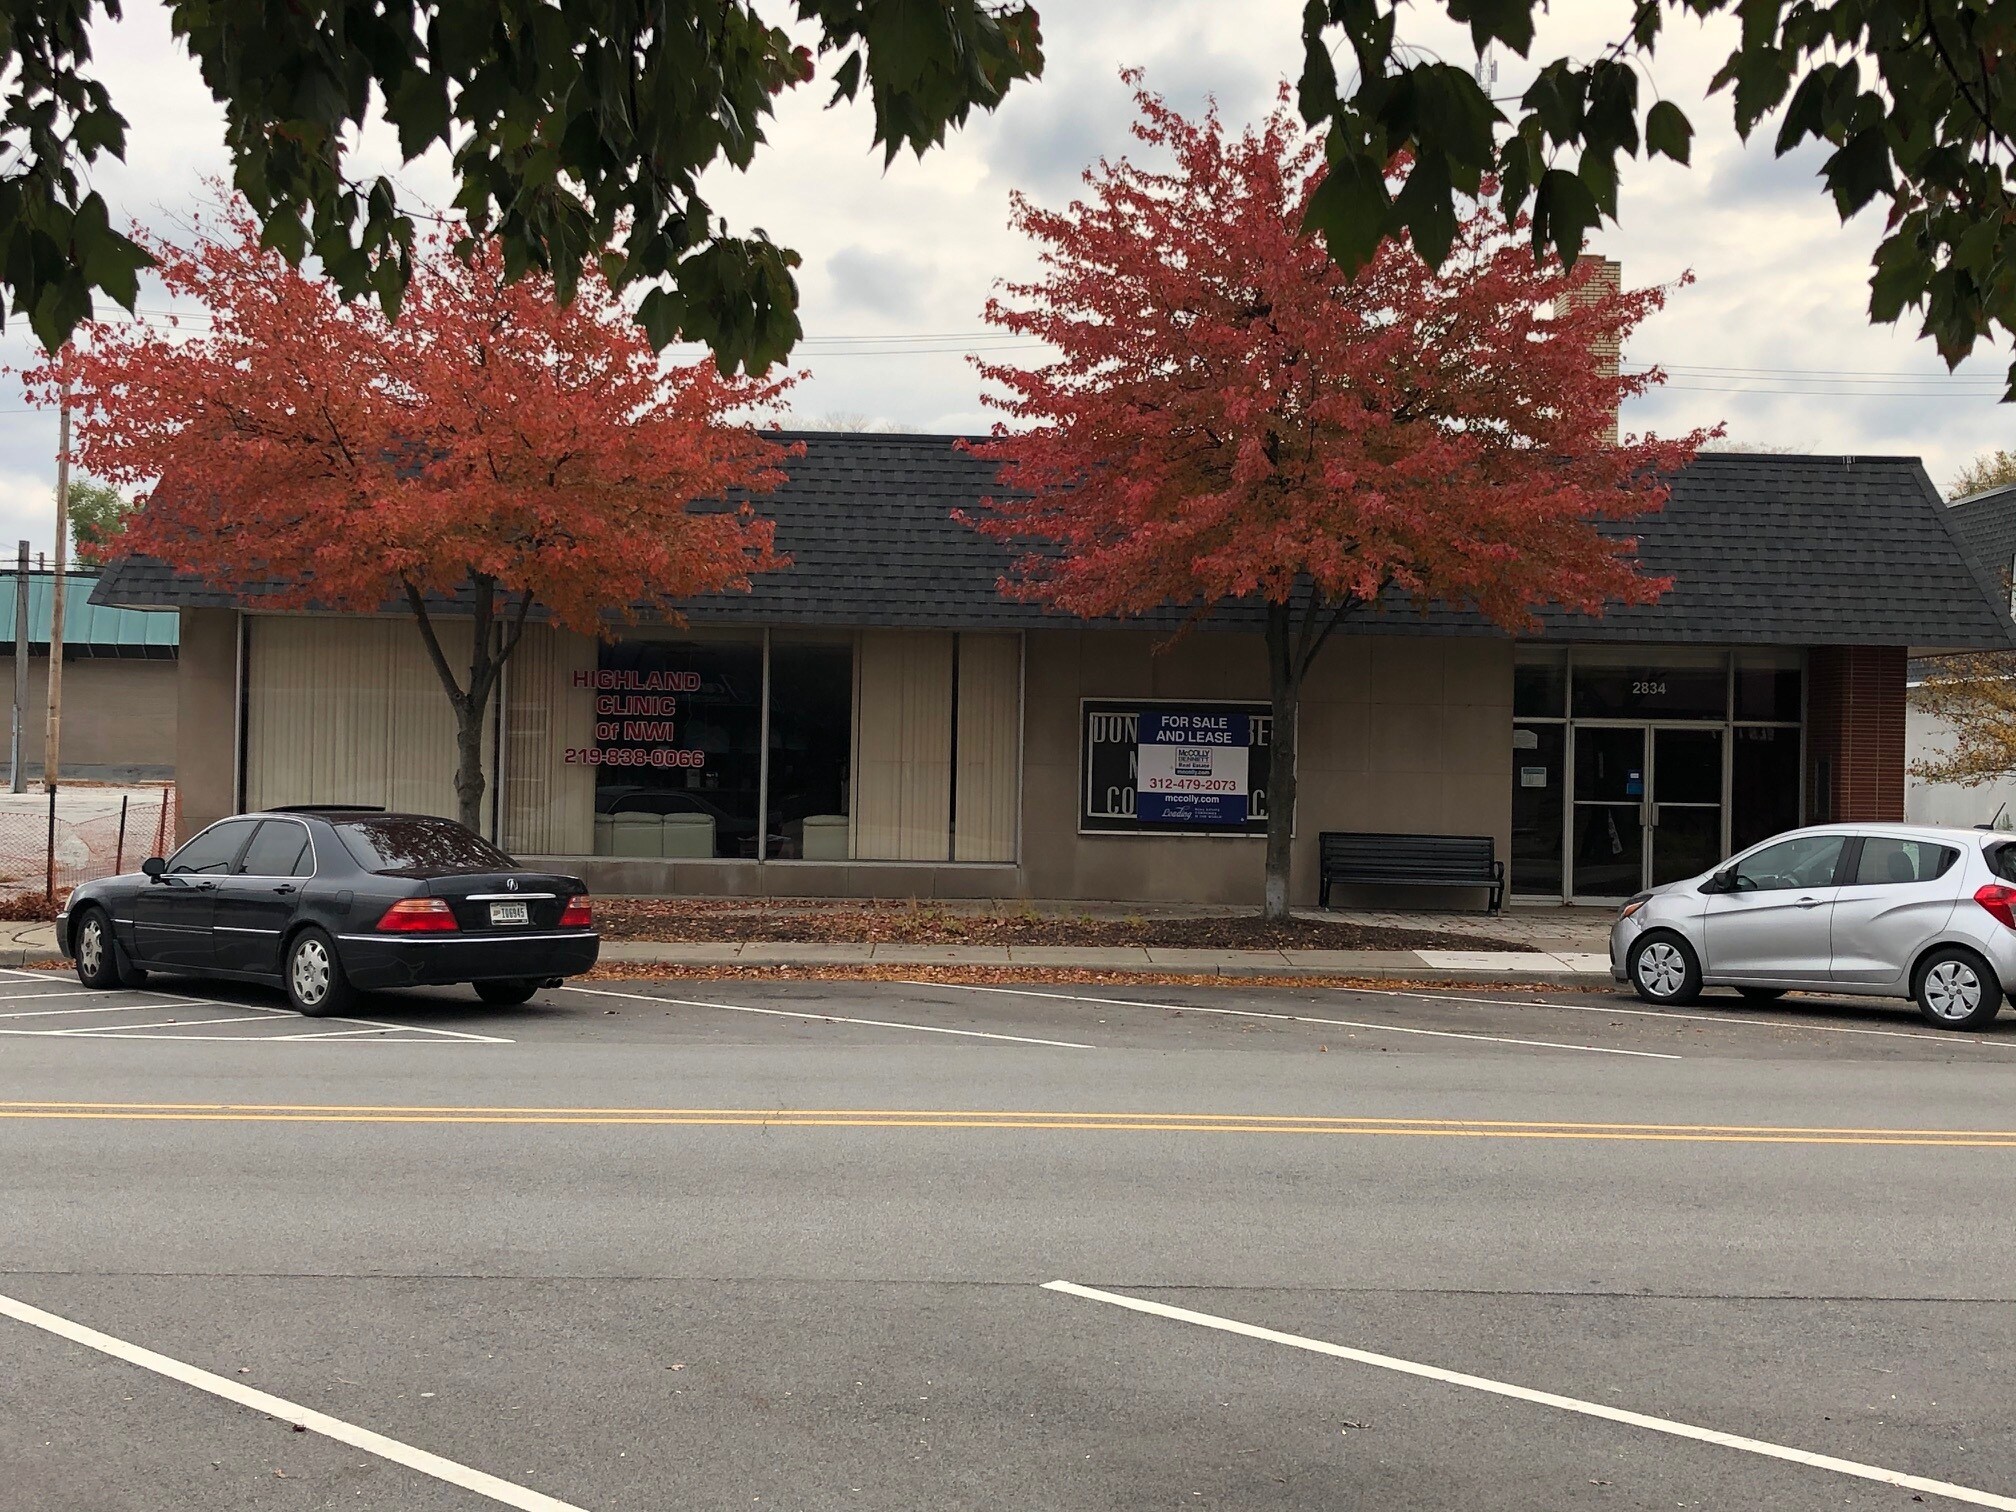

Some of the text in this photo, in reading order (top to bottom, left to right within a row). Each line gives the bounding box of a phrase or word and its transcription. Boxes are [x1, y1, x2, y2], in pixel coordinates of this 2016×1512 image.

[573, 670, 700, 692] HIGHLAND
[1632, 681, 1667, 695] 2834
[597, 695, 676, 716] CLINIC
[1161, 715, 1228, 729] FOR SALE
[624, 721, 674, 742] NWI
[1156, 730, 1232, 744] AND LEASE
[564, 748, 705, 768] 219-838-0066
[1149, 777, 1236, 791] 312-479-2073
[1164, 794, 1220, 804] mccolly.com
